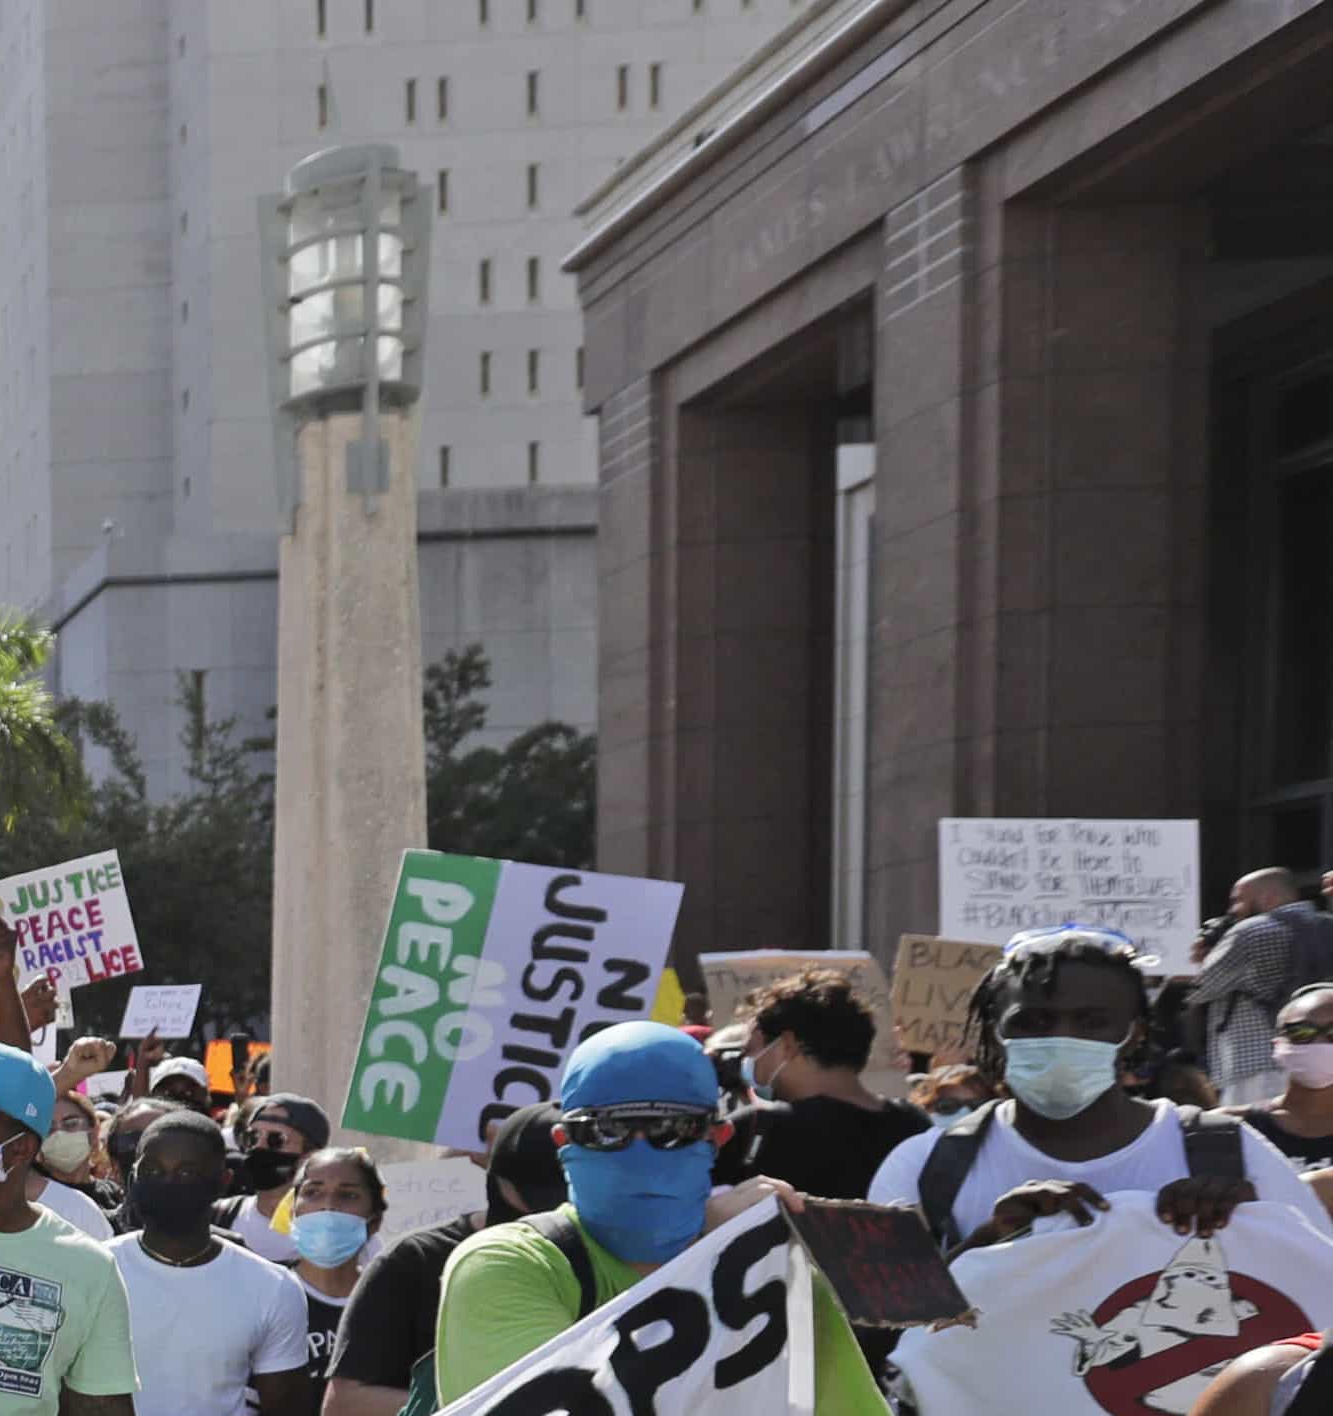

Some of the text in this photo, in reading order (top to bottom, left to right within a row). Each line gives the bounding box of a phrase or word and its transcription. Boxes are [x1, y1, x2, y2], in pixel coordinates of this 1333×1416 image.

[15, 898, 104, 948] PEACE
[22, 930, 104, 972] RACIST
[46, 944, 140, 987] PLICE
[910, 942, 997, 970] BLAC
[359, 877, 475, 1113] PEACE
[901, 979, 967, 1011] LIV
